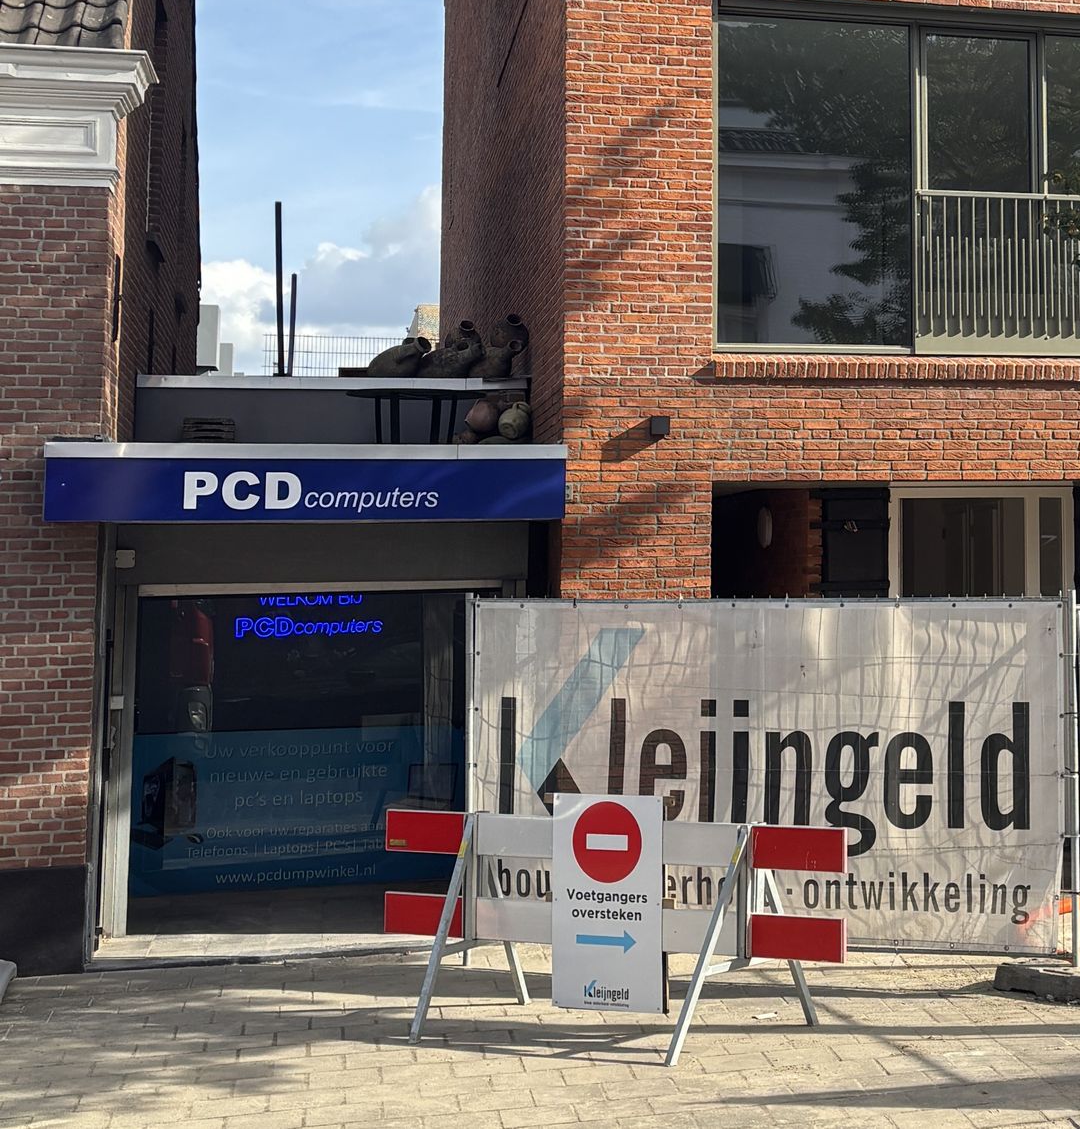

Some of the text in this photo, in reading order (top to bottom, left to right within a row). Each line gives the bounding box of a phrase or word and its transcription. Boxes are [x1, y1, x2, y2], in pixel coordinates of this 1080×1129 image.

[204, 740, 395, 759] Uw verkooppunt voor
[500, 628, 1031, 858] Kleijngeld
[209, 763, 389, 784] nieuwe en gebruikte
[272, 793, 294, 807] en
[299, 789, 364, 807] laptops
[206, 826, 233, 839] Ook
[235, 827, 265, 839] voor
[186, 844, 249, 860] Telefoons
[362, 837, 385, 850] Tab
[215, 863, 377, 885] www.pcdumpwinkel.nl
[498, 859, 1031, 925] bou ontwikkeling
[566, 888, 648, 905] Voetgangers
[571, 908, 642, 922] oversteken
[583, 979, 630, 1002] Kleijngeld
